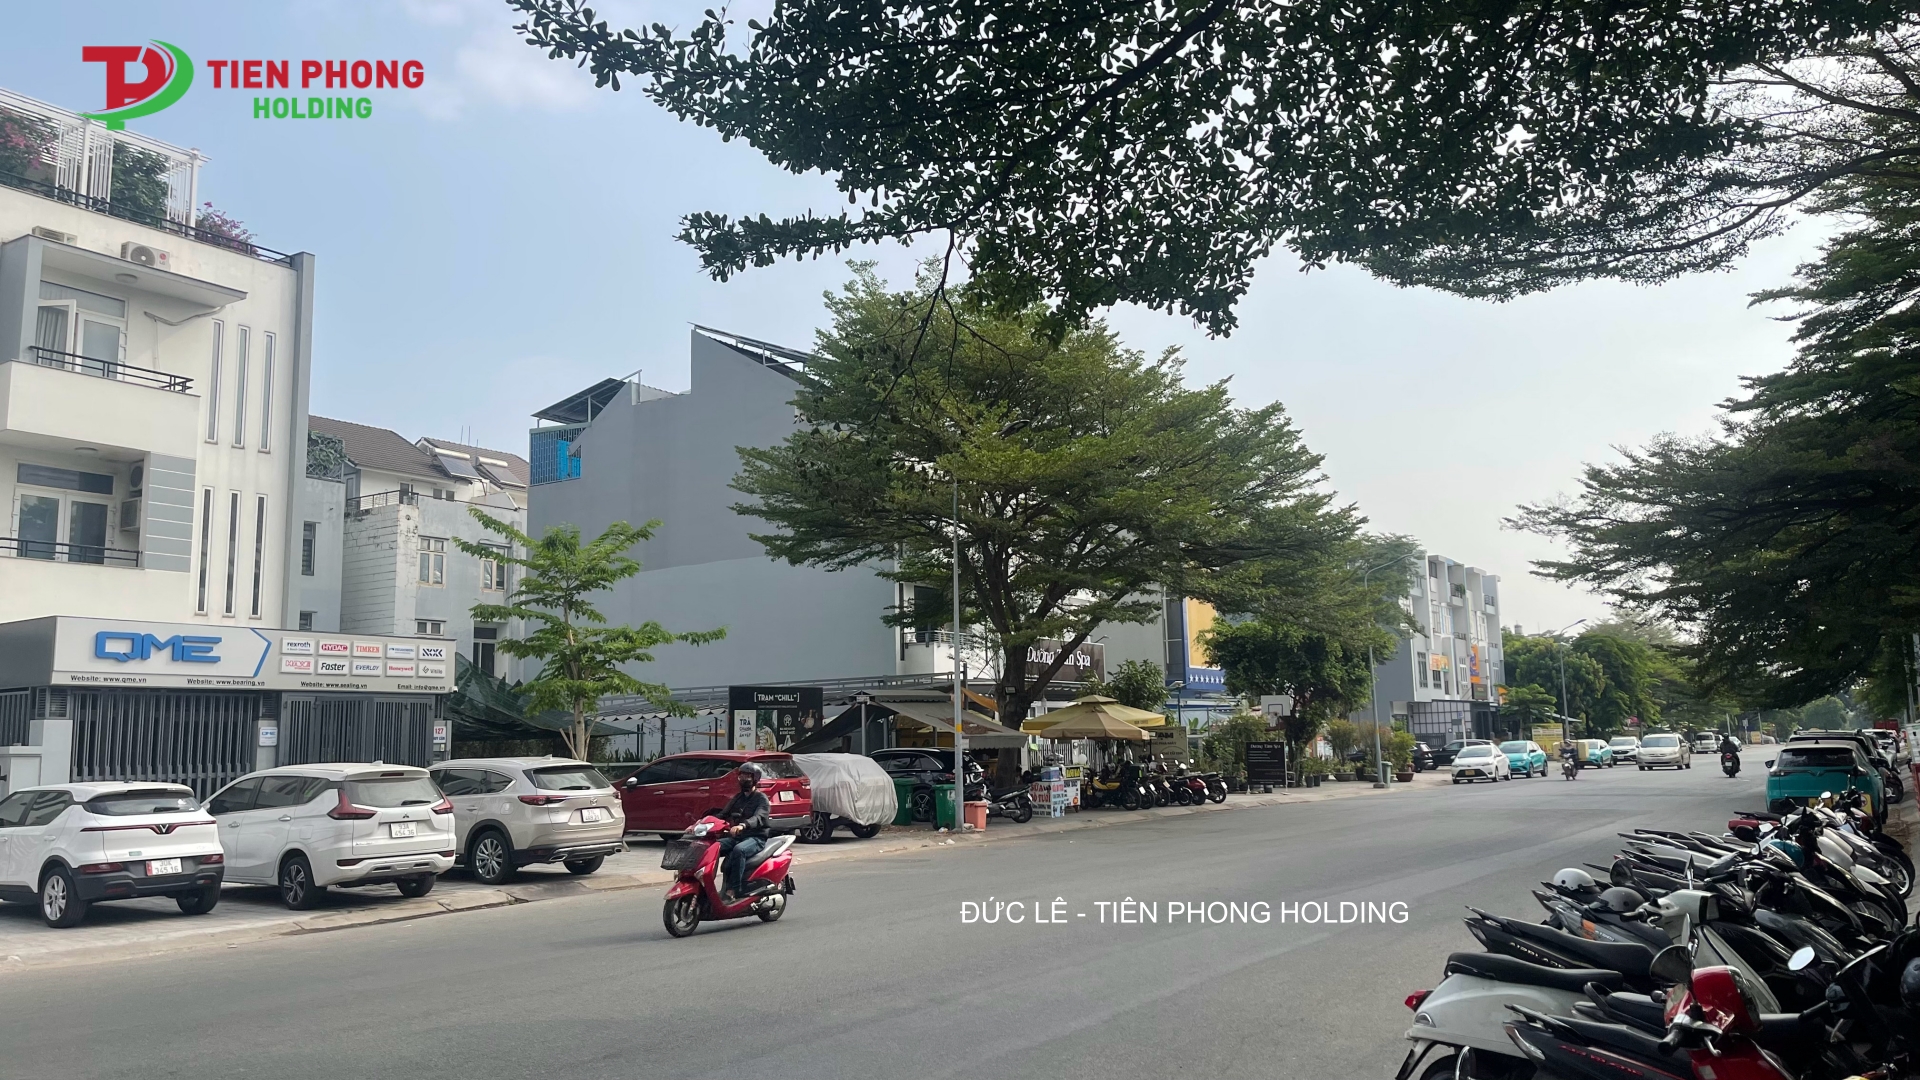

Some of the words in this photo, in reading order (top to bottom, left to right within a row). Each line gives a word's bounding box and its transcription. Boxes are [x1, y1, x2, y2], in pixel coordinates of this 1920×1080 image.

[95, 630, 223, 663] QME
[322, 643, 348, 652] HYDAC
[355, 645, 380, 653] TIMKEN
[1076, 650, 1091, 670] Spa
[320, 662, 346, 671] Faster
[70, 674, 101, 682] Website:
[103, 676, 147, 684] www.qme.vn
[186, 677, 215, 685] Website:
[215, 679, 266, 687] www.bearing.vn
[300, 680, 325, 688] Website:
[757, 693, 774, 703] TRẠM
